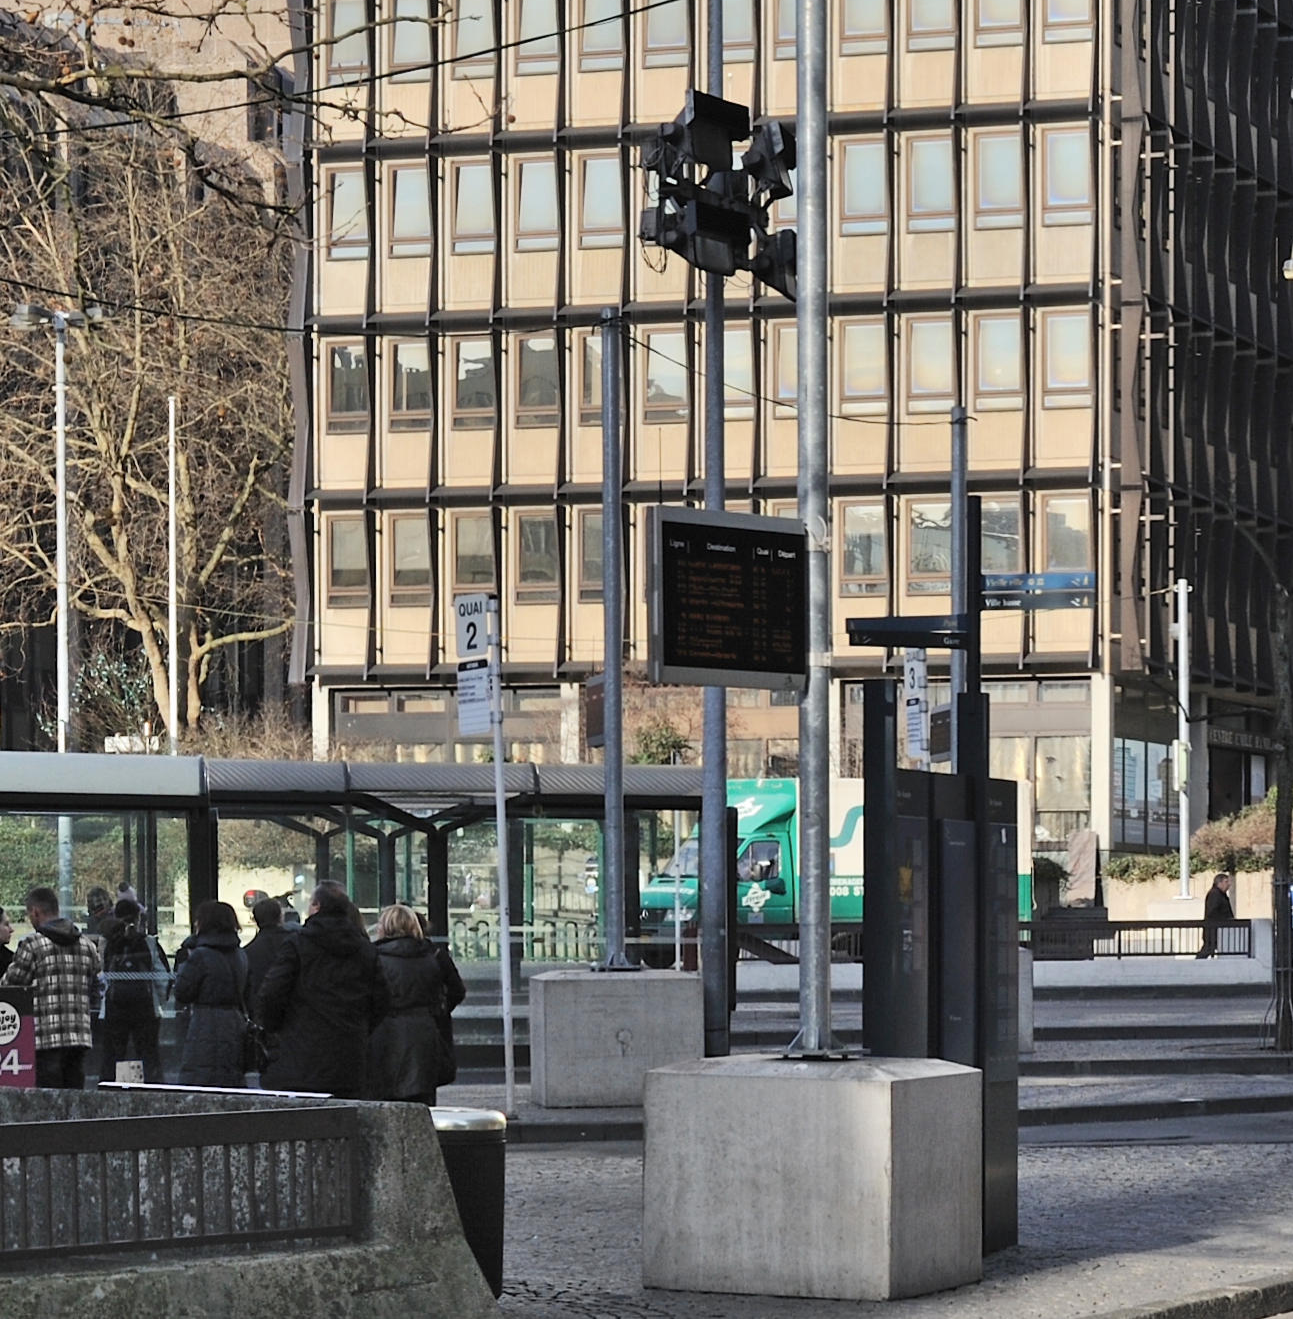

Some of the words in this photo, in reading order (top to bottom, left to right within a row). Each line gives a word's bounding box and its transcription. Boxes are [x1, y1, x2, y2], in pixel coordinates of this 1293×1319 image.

[669, 539, 685, 548] Ligne
[706, 542, 736, 553] Destination
[458, 601, 483, 617] QUAI
[985, 598, 1001, 607] Ville
[466, 621, 478, 650] 2
[943, 636, 960, 645] Gare
[909, 667, 915, 689] 3
